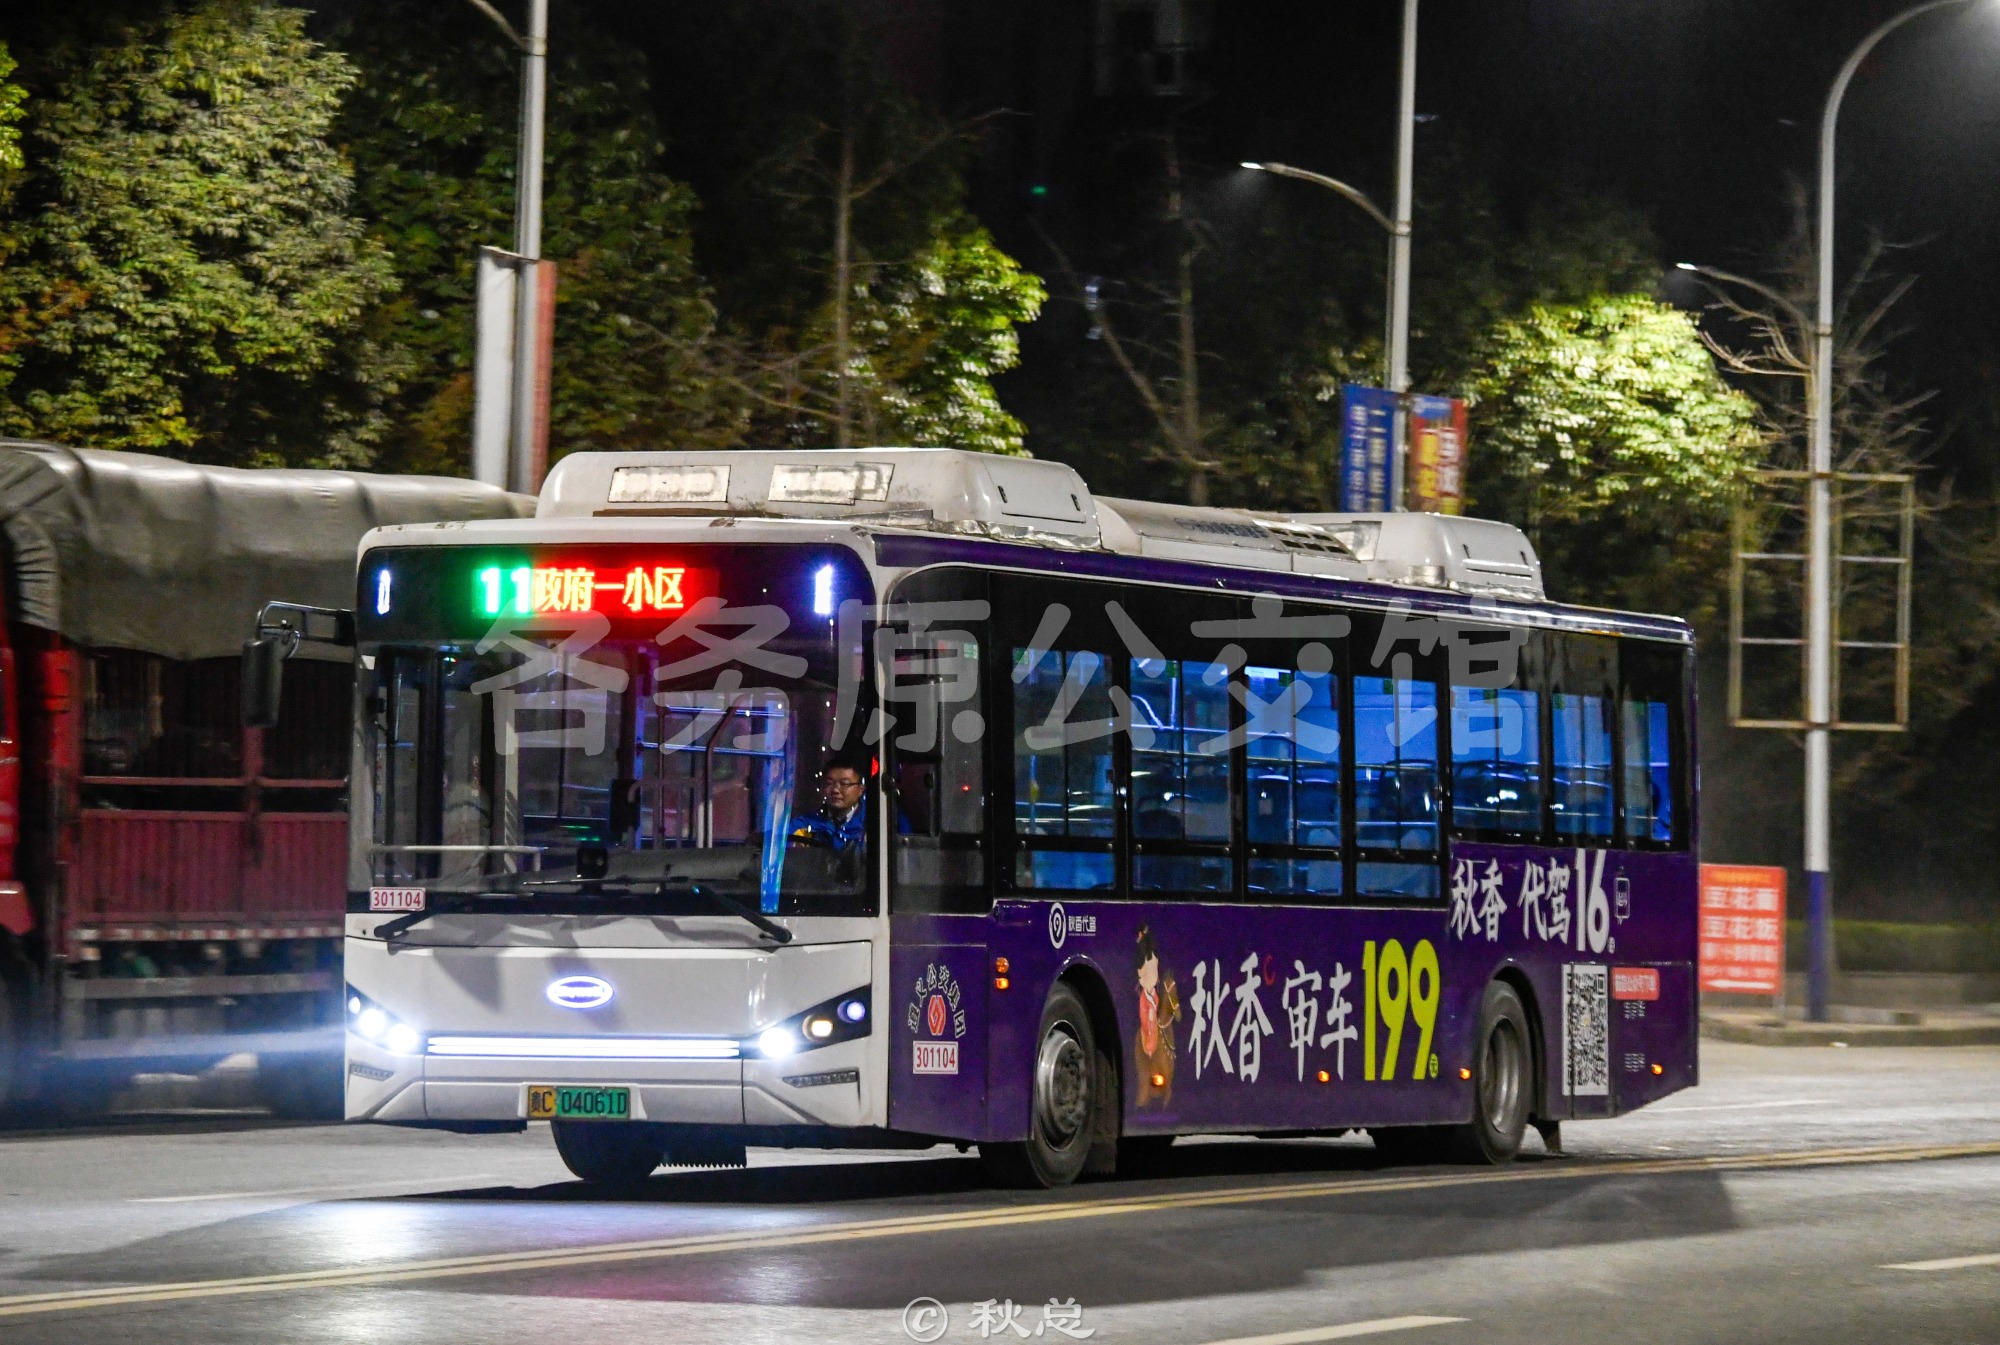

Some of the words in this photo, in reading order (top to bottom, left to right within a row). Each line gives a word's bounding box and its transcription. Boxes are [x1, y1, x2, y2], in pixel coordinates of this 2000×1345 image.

[480, 567, 531, 613] 11
[373, 890, 422, 907] 301104
[1450, 857, 1507, 942] 秋香
[1517, 857, 1571, 944] 代驾
[1575, 848, 1610, 953] 16
[1188, 951, 1274, 1083] 秋香
[1281, 959, 1359, 1083] 审车
[1362, 939, 1441, 1081] 199
[916, 1047, 957, 1069] 301104
